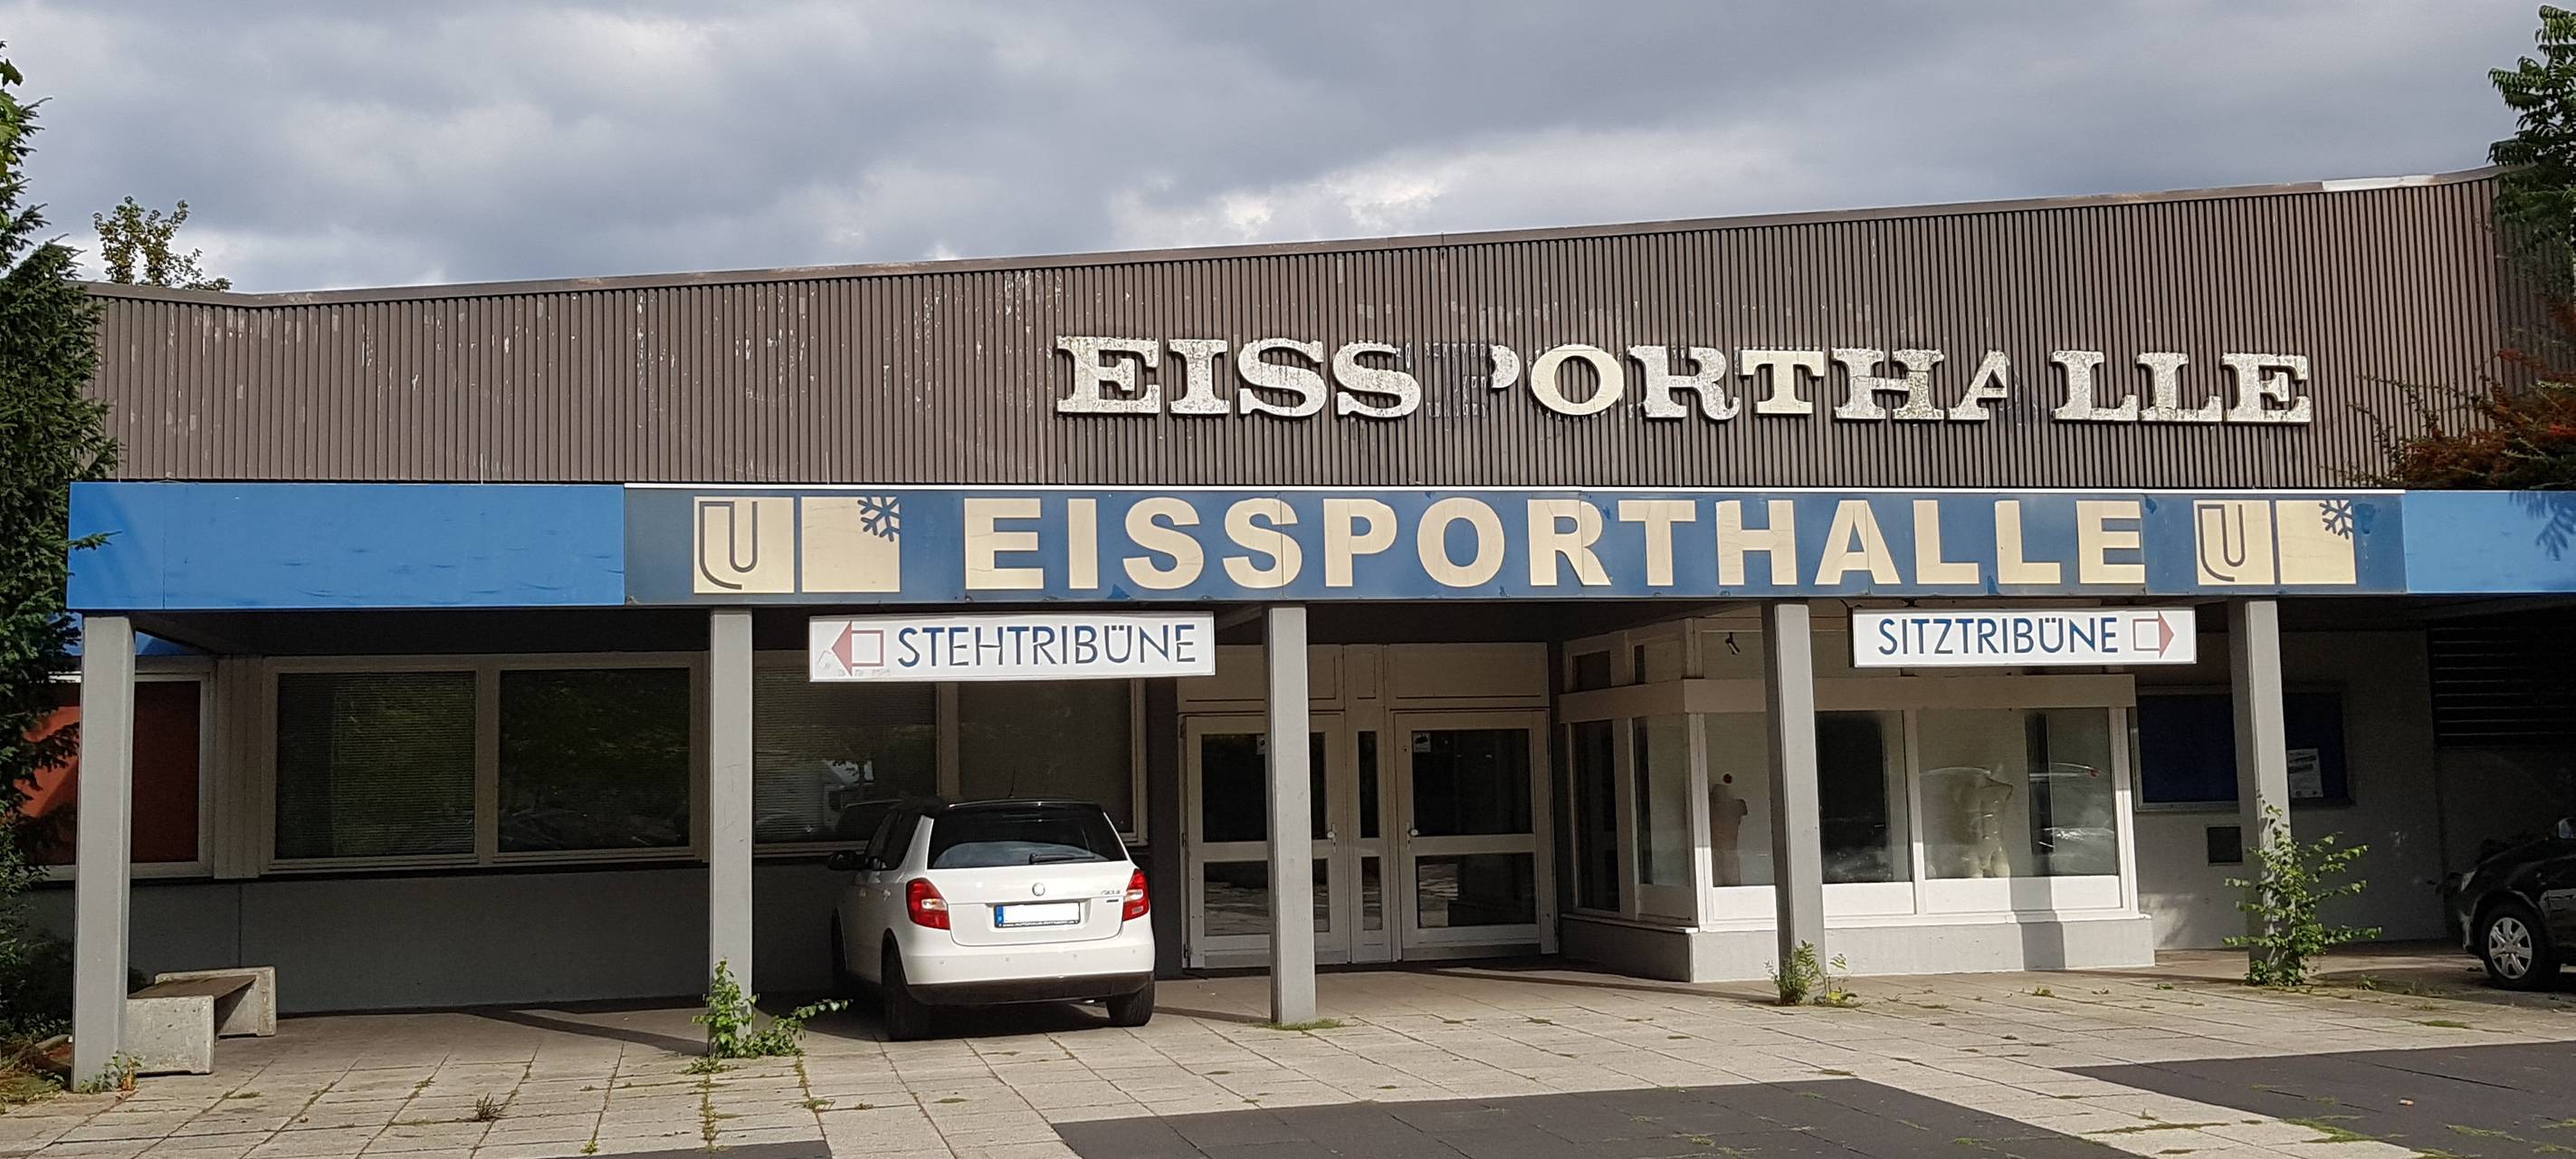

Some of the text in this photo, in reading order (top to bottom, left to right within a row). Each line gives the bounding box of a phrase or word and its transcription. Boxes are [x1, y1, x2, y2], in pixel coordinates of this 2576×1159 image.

[964, 496, 2145, 591] EISSPORTHALLE
[897, 623, 1197, 669] STEHTRIBÜNE
[1877, 616, 2119, 656] SITZTRIBÜNE
